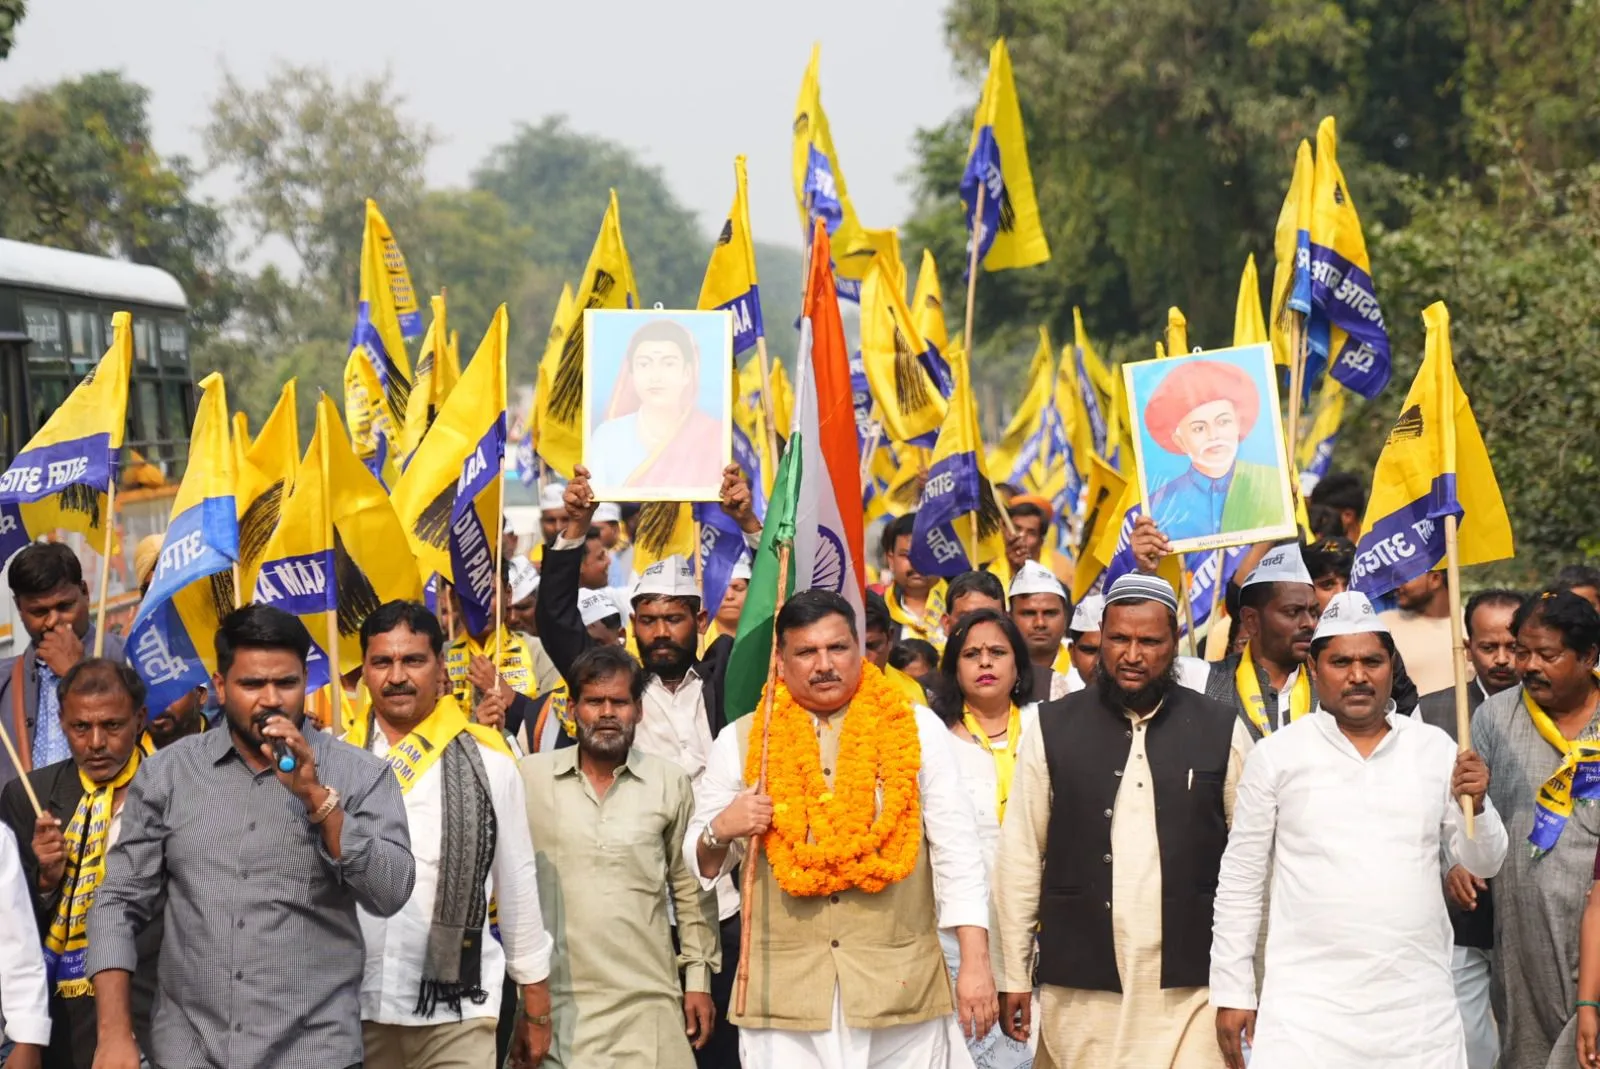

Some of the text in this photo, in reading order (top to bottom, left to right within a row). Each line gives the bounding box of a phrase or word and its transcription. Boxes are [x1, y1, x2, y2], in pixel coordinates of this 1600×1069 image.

[452, 509, 483, 559] DMI
[1261, 552, 1286, 567] पार्टी
[136, 624, 190, 686] पार्टी
